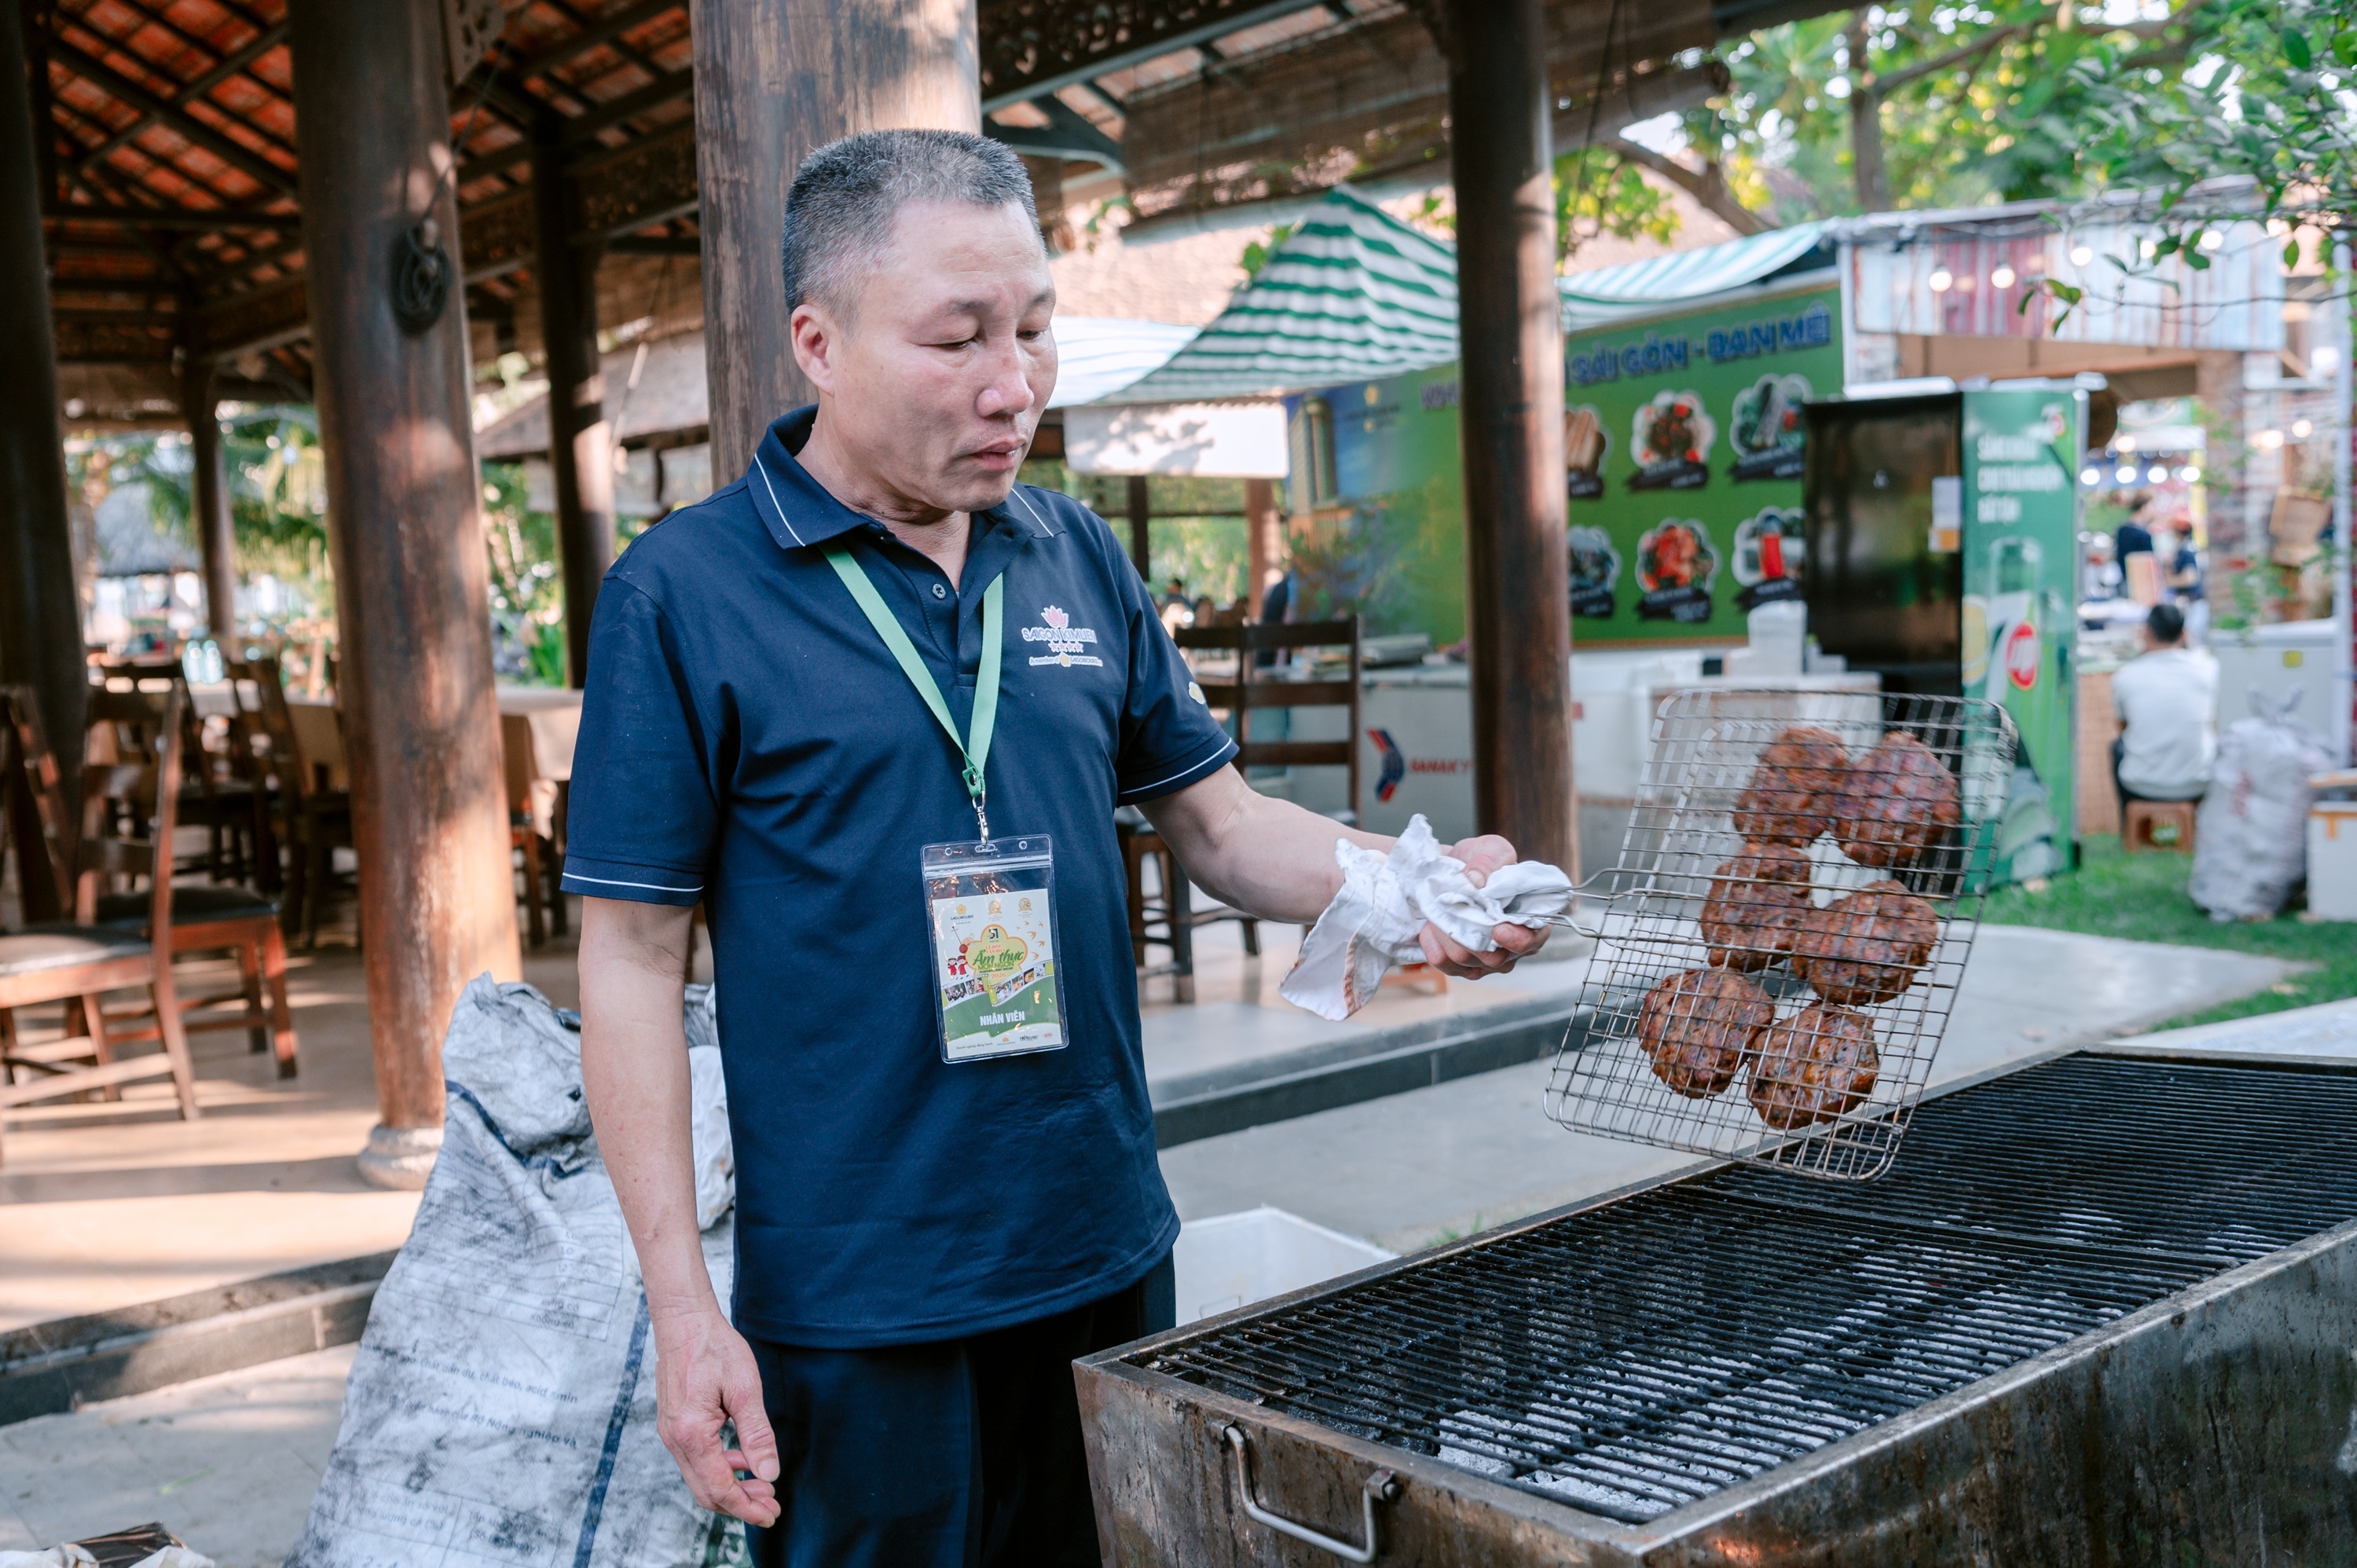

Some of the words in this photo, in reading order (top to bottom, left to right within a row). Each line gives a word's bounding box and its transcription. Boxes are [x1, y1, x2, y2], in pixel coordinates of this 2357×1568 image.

[1706, 321, 1776, 362] BAN
[1022, 628, 1062, 641] SAIGON
[999, 949, 1024, 963] thực
[980, 1012, 1004, 1026] NHÂN
[1005, 1009, 1025, 1023] VIÊN
[525, 1383, 548, 1398] acid
